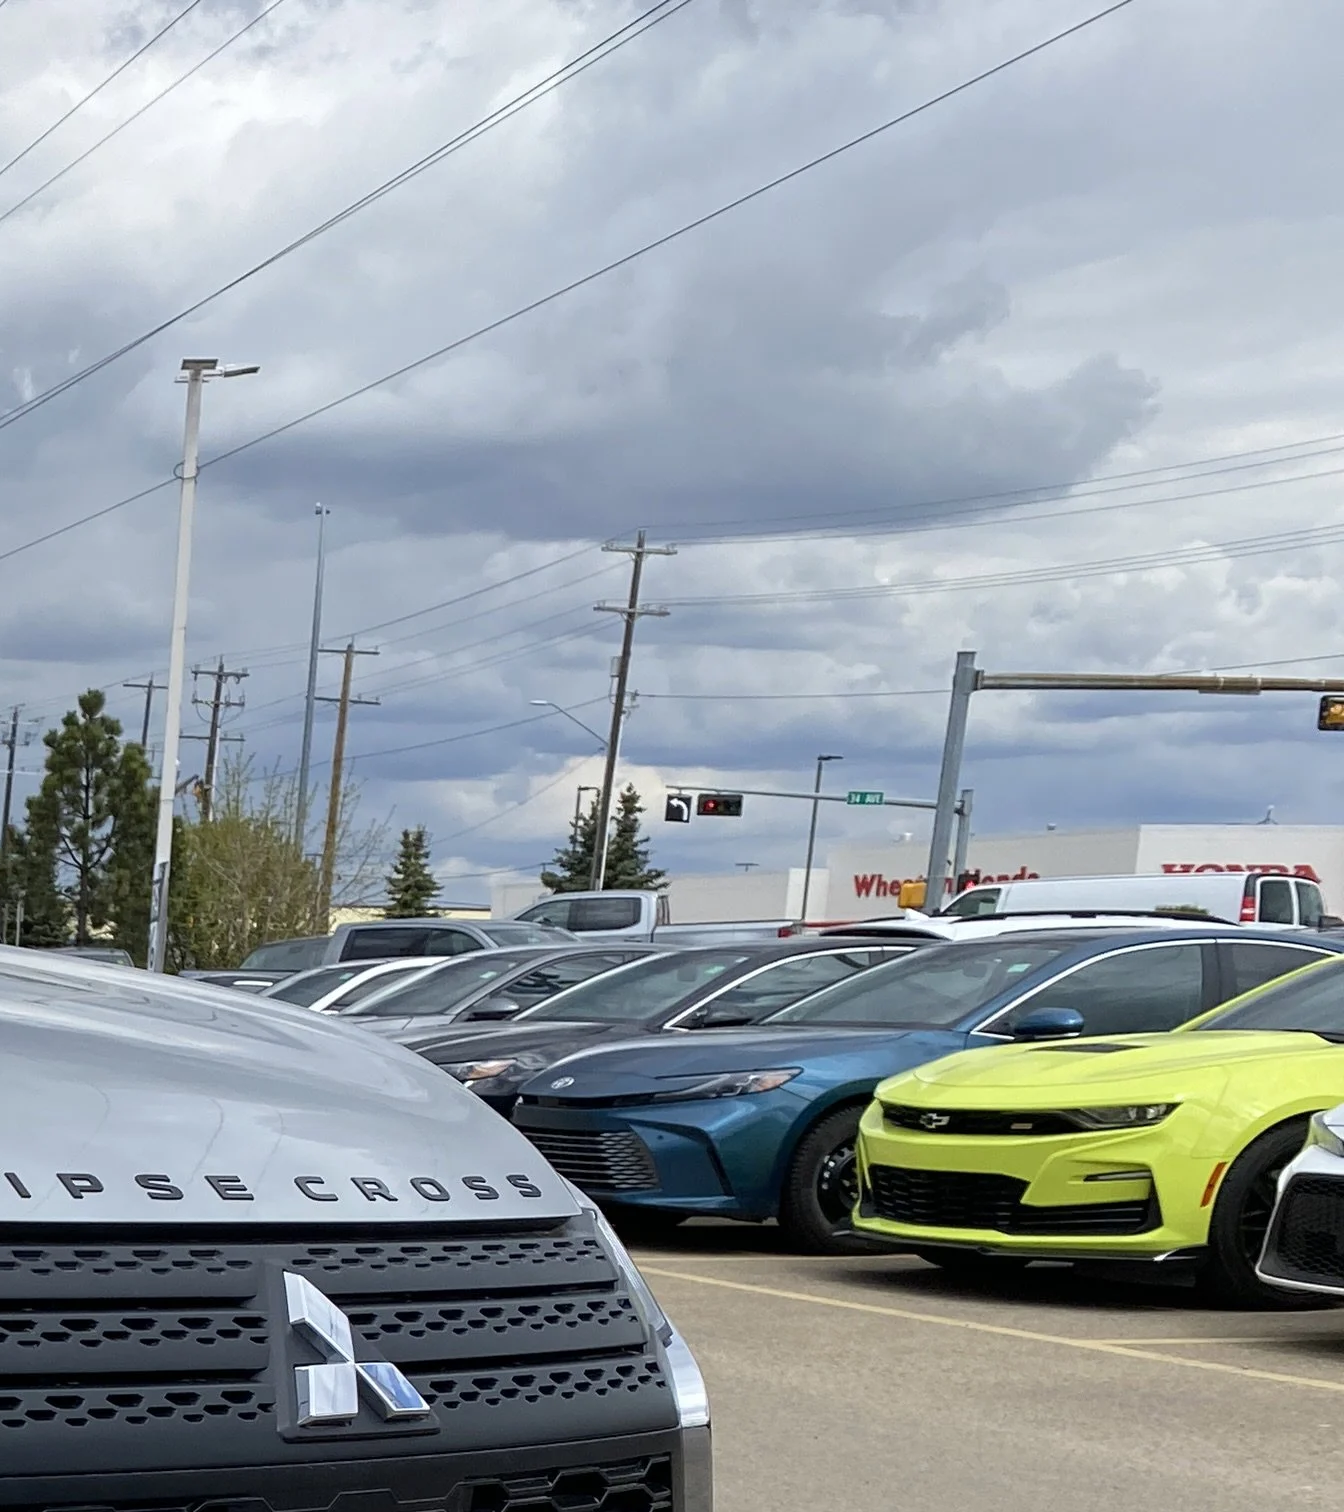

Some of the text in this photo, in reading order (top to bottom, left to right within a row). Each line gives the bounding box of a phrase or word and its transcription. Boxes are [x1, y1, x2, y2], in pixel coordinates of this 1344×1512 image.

[865, 793, 882, 804] AVE
[854, 873, 953, 898] When
[293, 1174, 543, 1202] CROSS
